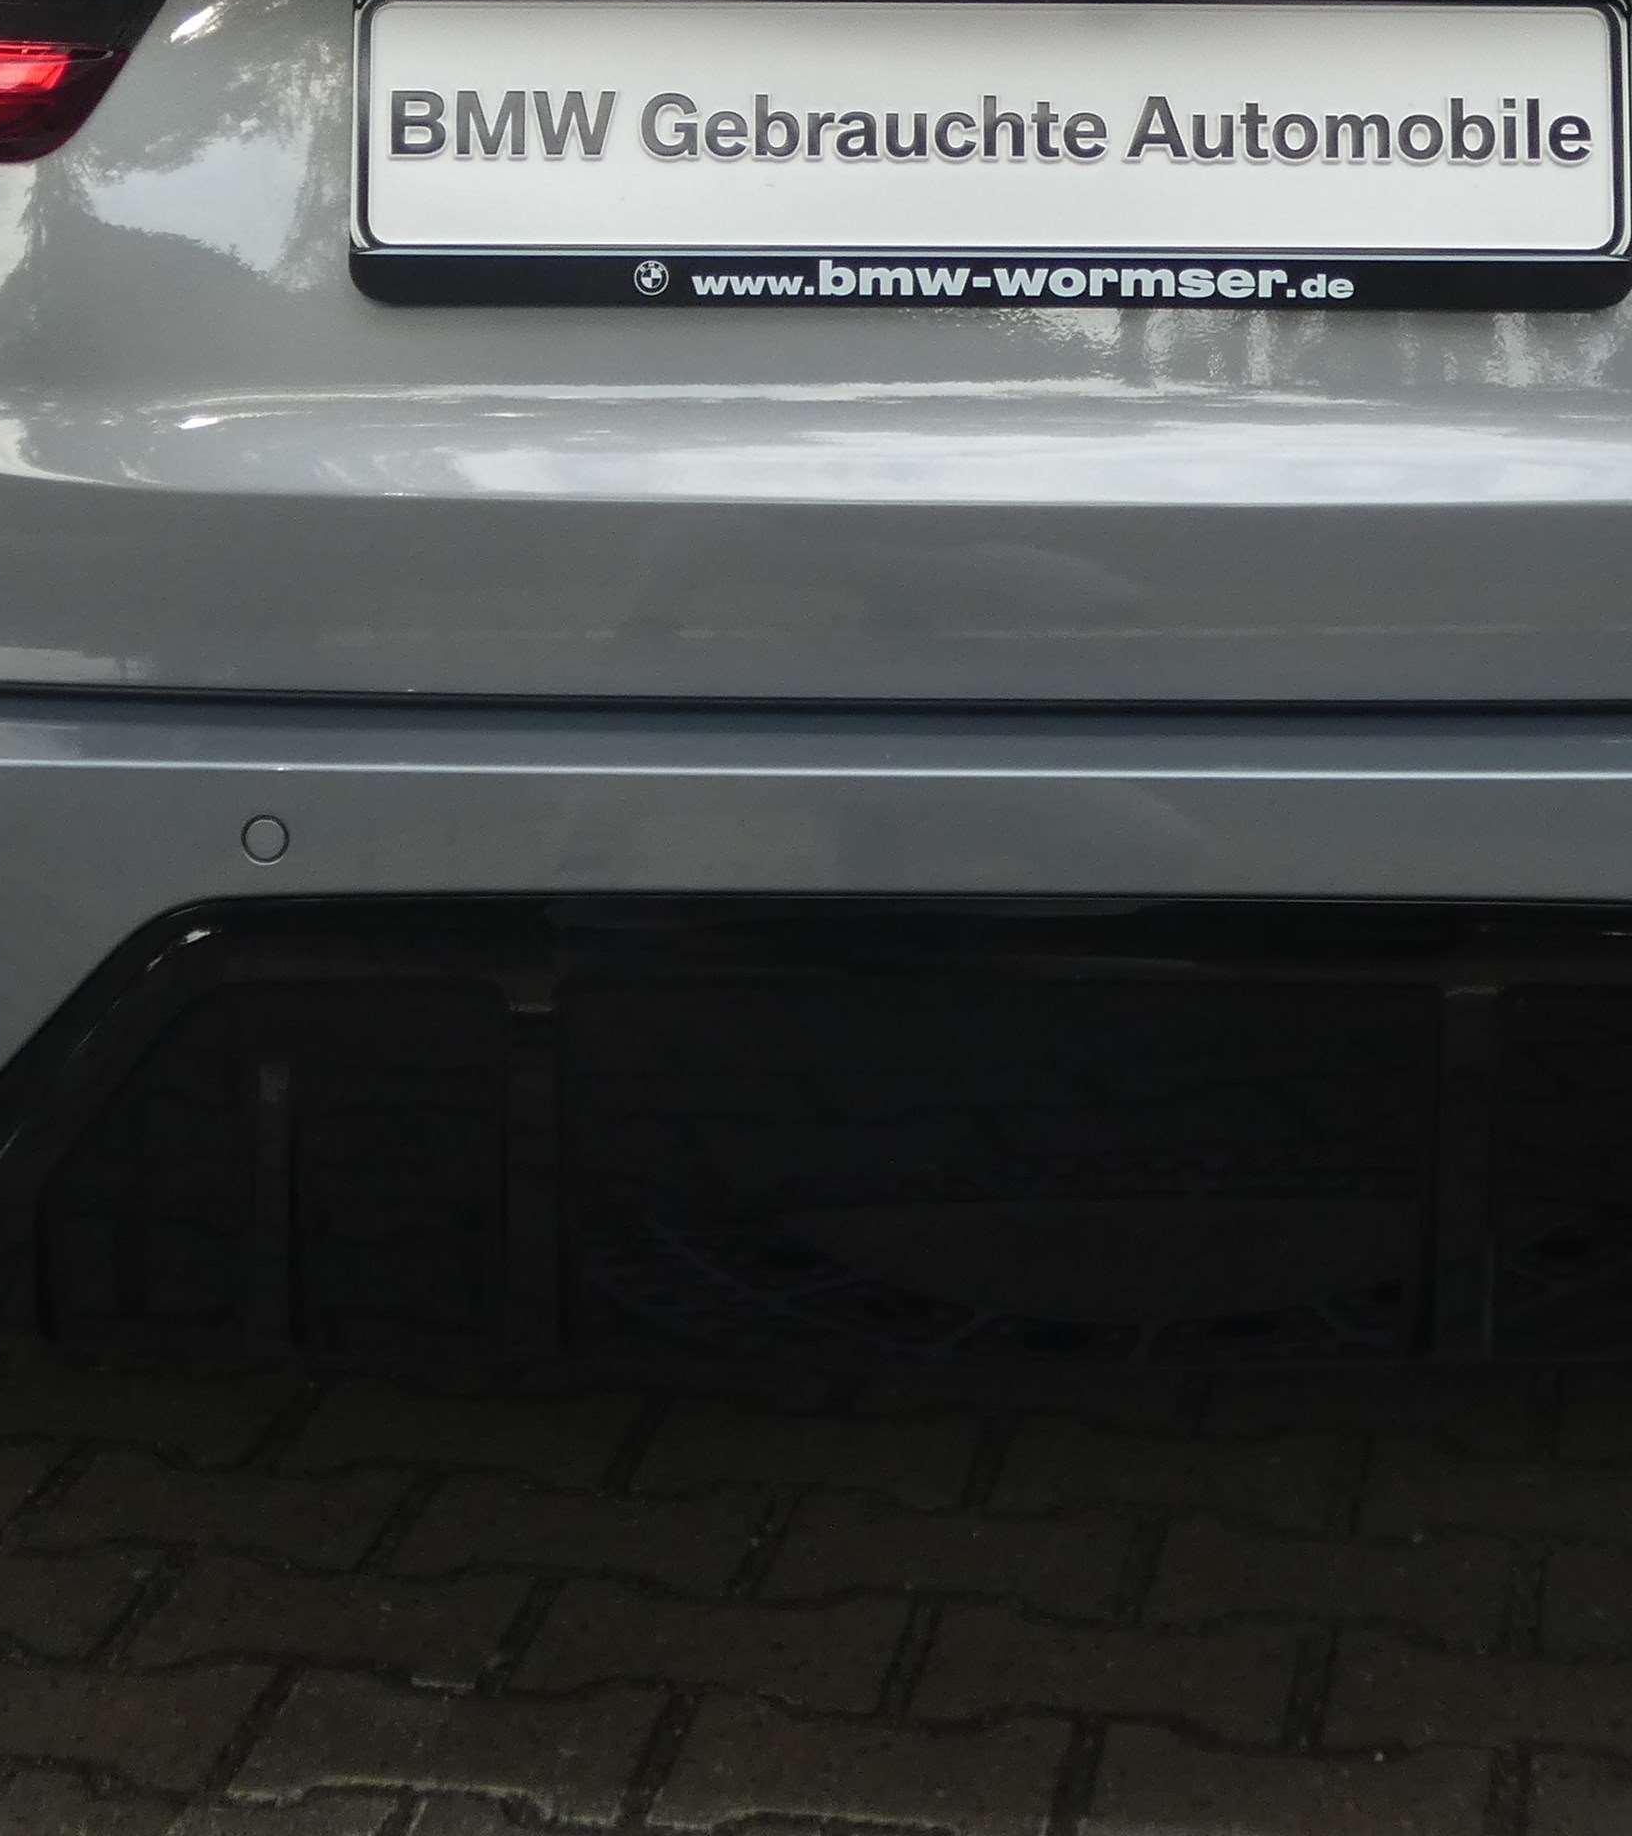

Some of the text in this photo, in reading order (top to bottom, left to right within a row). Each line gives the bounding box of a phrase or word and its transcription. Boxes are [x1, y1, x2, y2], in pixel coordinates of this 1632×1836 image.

[389, 90, 1592, 165] BMW Gebrauchte Automobile
[691, 260, 1356, 299] www.bmw-wormser.de
